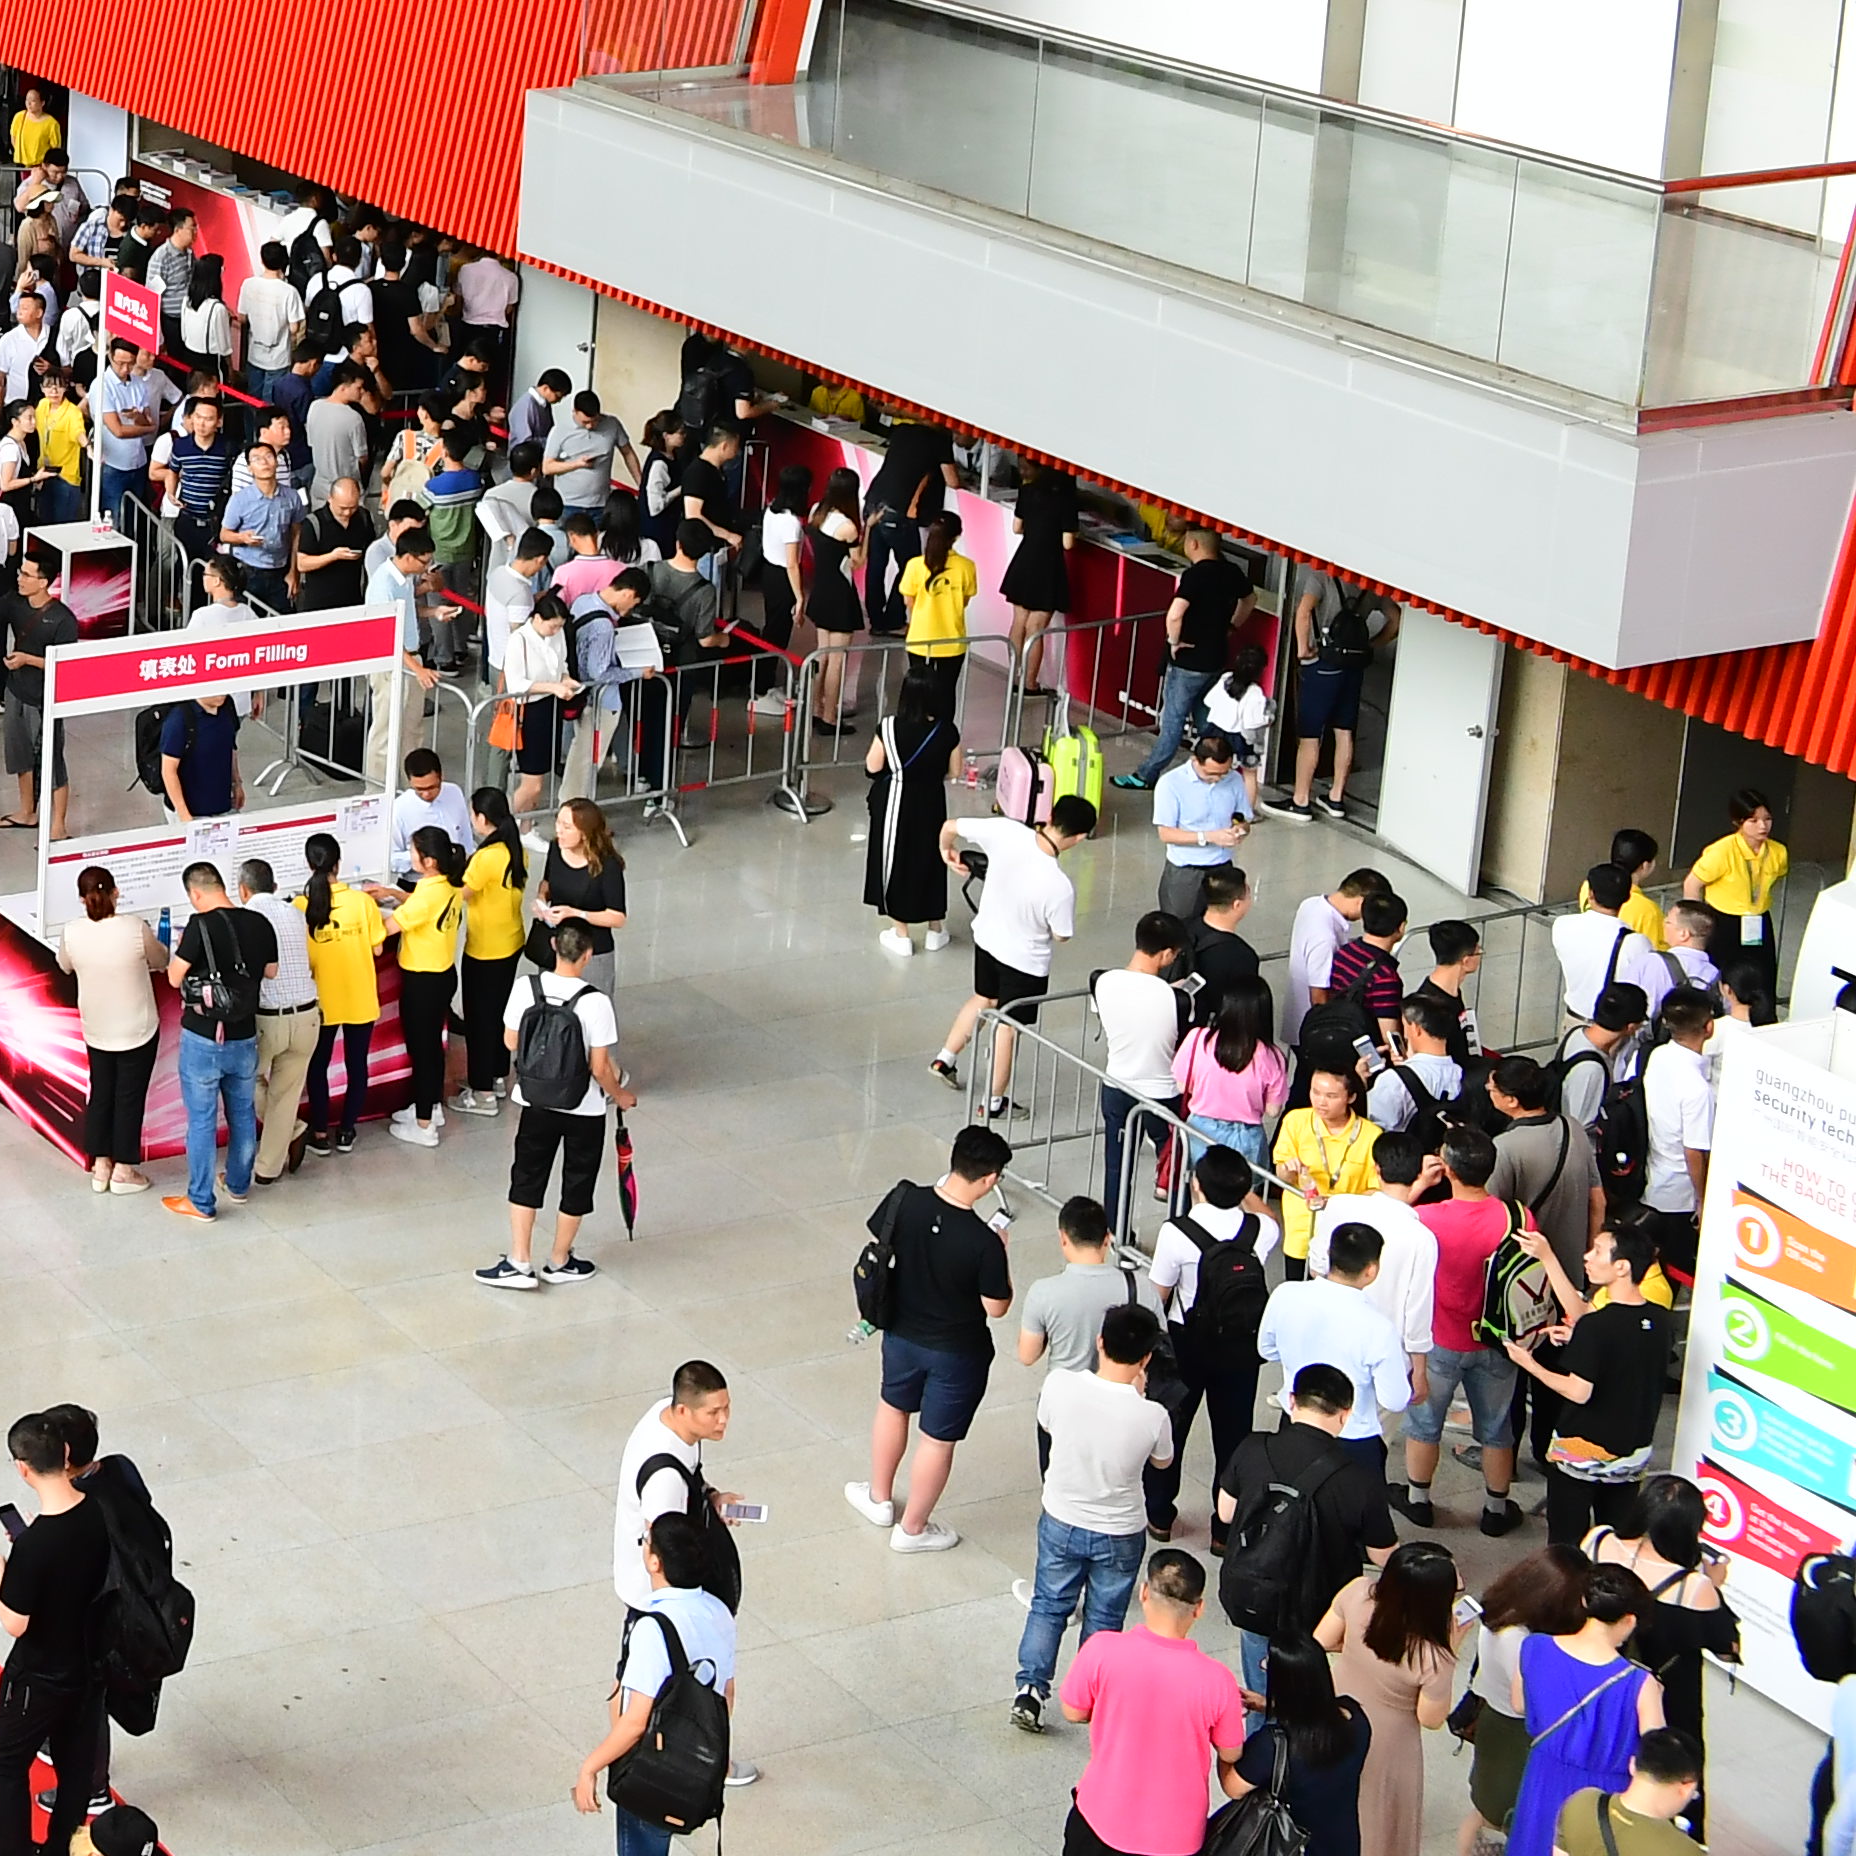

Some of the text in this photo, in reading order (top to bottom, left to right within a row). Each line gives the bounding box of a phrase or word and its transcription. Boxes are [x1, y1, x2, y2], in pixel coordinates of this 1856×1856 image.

[138, 643, 308, 683] 填表处 Form Filling
[1753, 1088, 1817, 1130] security
[1754, 1067, 1834, 1116] guangzhou
[1760, 1162, 1848, 1218] THE BADGE
[1783, 1156, 1848, 1200] HOW TO
[1743, 1220, 1763, 1251] 1
[1730, 1310, 1755, 1346] 2
[1720, 1405, 1743, 1436] 3
